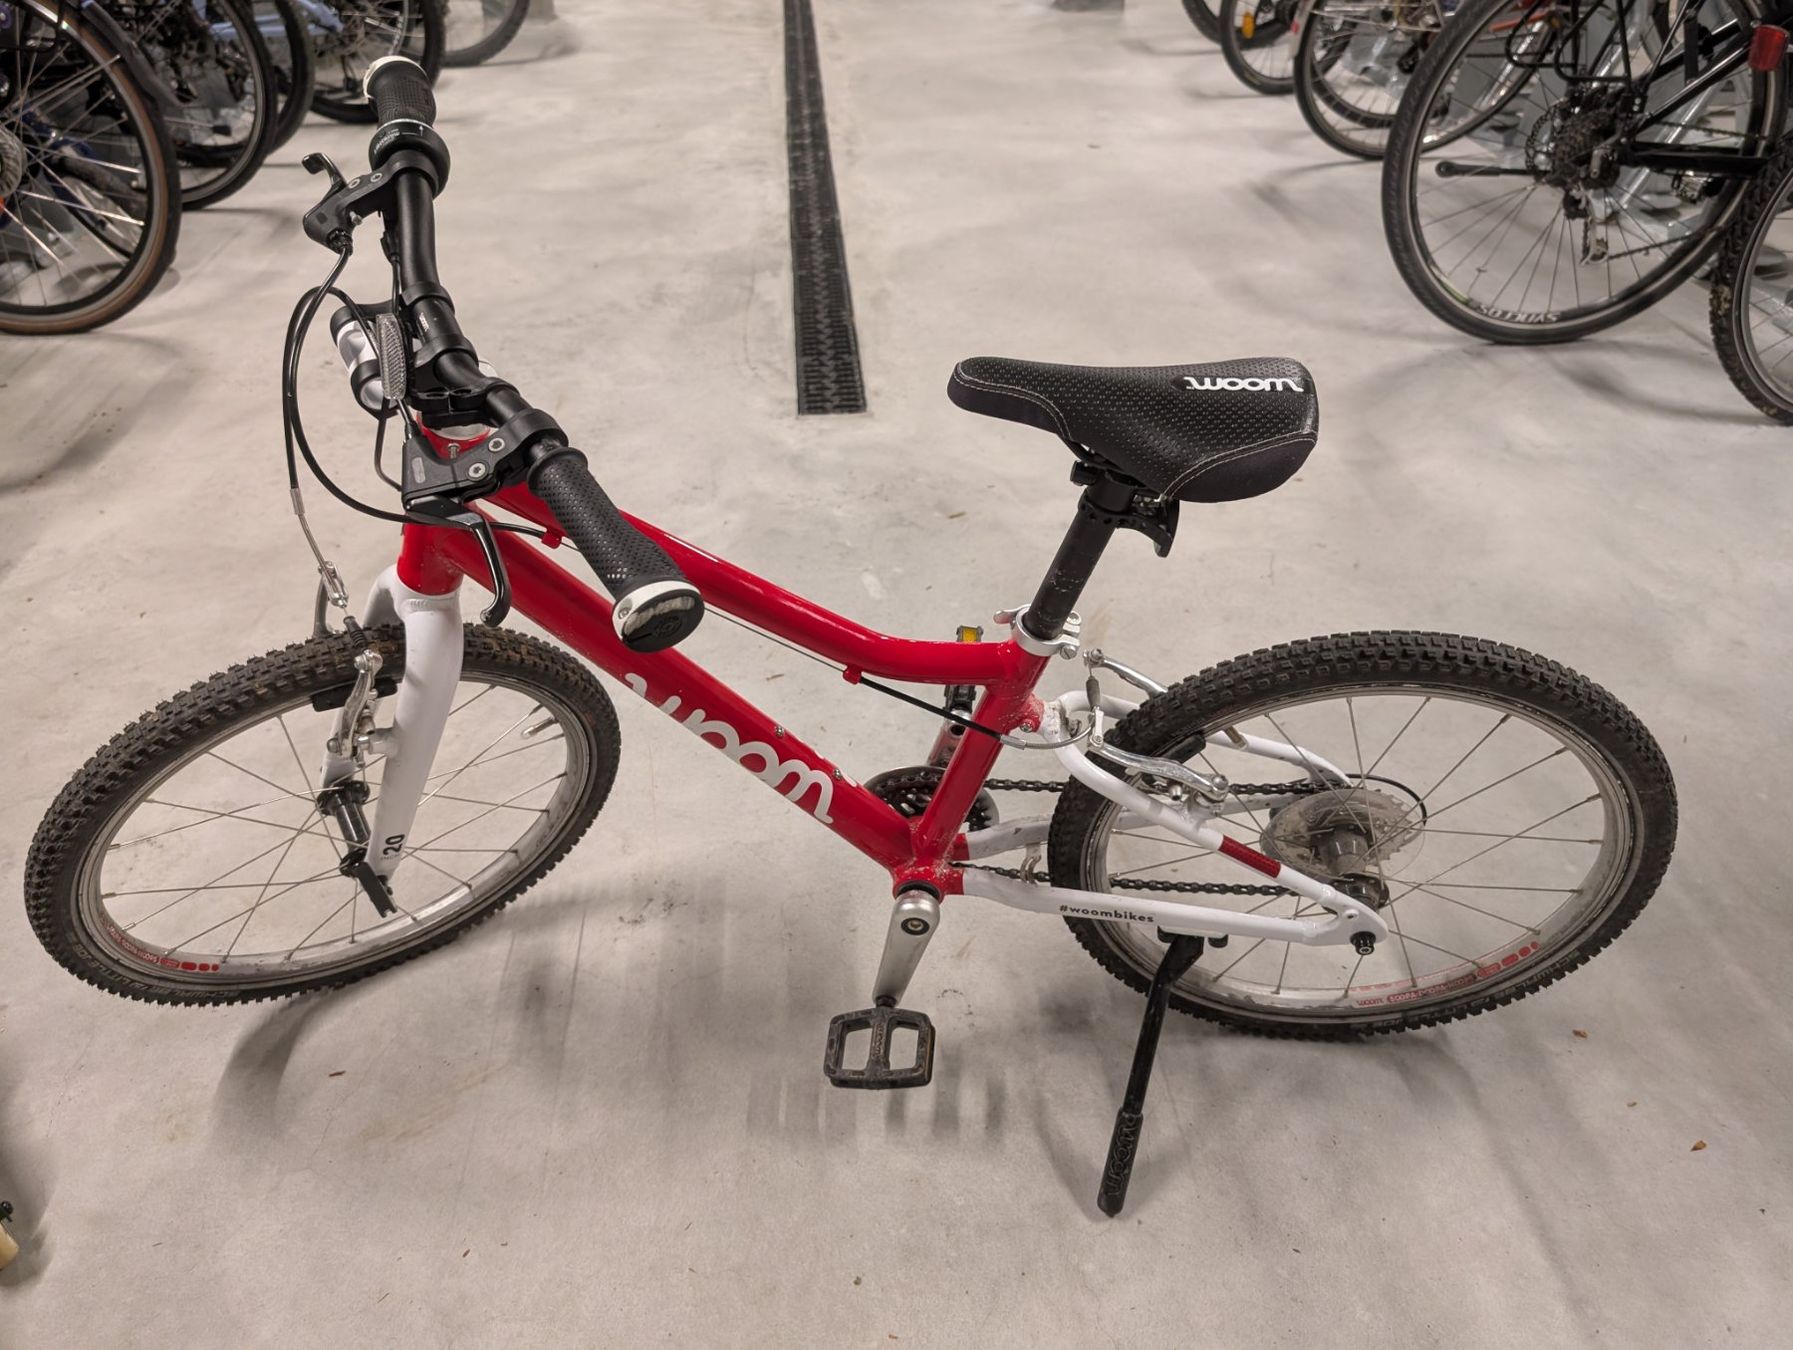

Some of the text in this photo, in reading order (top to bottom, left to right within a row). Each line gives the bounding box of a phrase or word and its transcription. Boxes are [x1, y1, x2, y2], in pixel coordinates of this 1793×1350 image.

[1184, 376, 1304, 393] woom
[382, 833, 405, 855] 20
[1060, 904, 1154, 923] #woombikes
